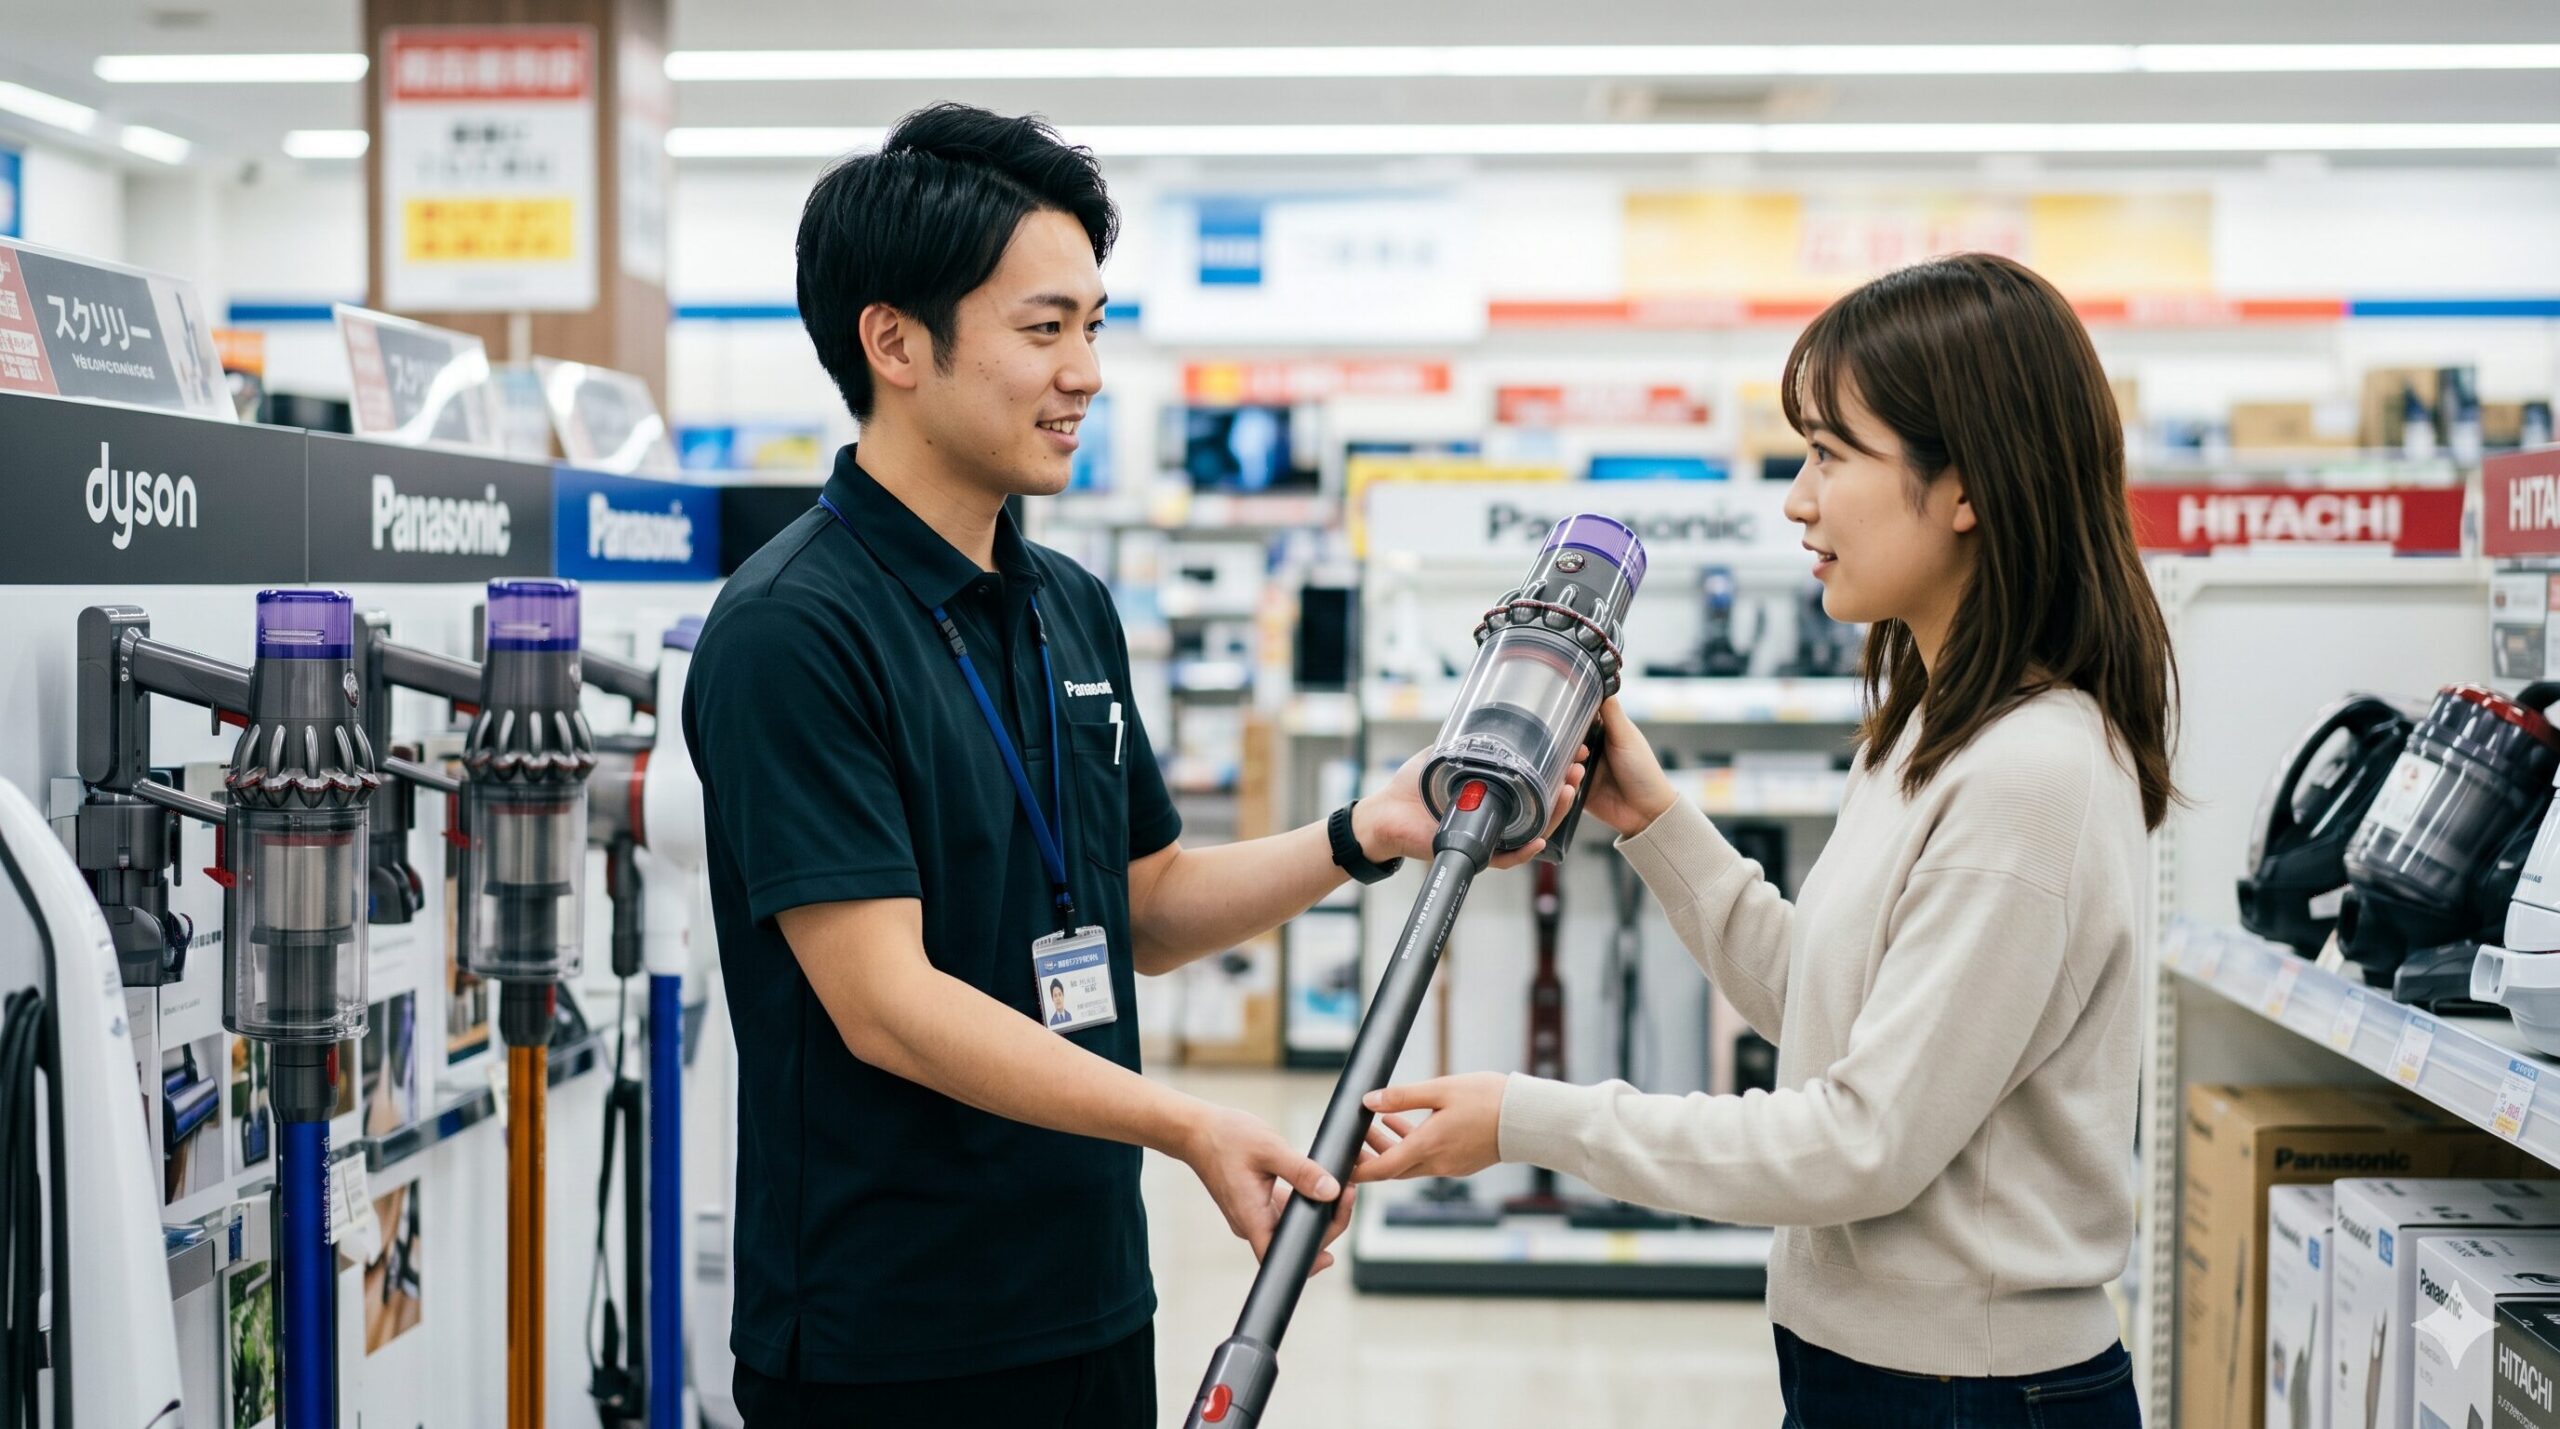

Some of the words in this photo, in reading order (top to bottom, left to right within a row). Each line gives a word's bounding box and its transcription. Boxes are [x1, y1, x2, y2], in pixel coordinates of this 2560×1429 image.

[47, 294, 151, 351] スクリリー
[86, 442, 197, 549] dyson
[372, 474, 511, 556] Panasonic
[1488, 499, 1757, 544] Paonic
[2179, 494, 2401, 542] HITACHI
[2509, 474, 2560, 531] HITA
[588, 492, 692, 562] Panasonic
[2274, 1147, 2411, 1172] Panasonic
[2498, 1342, 2552, 1413] HITACHI
